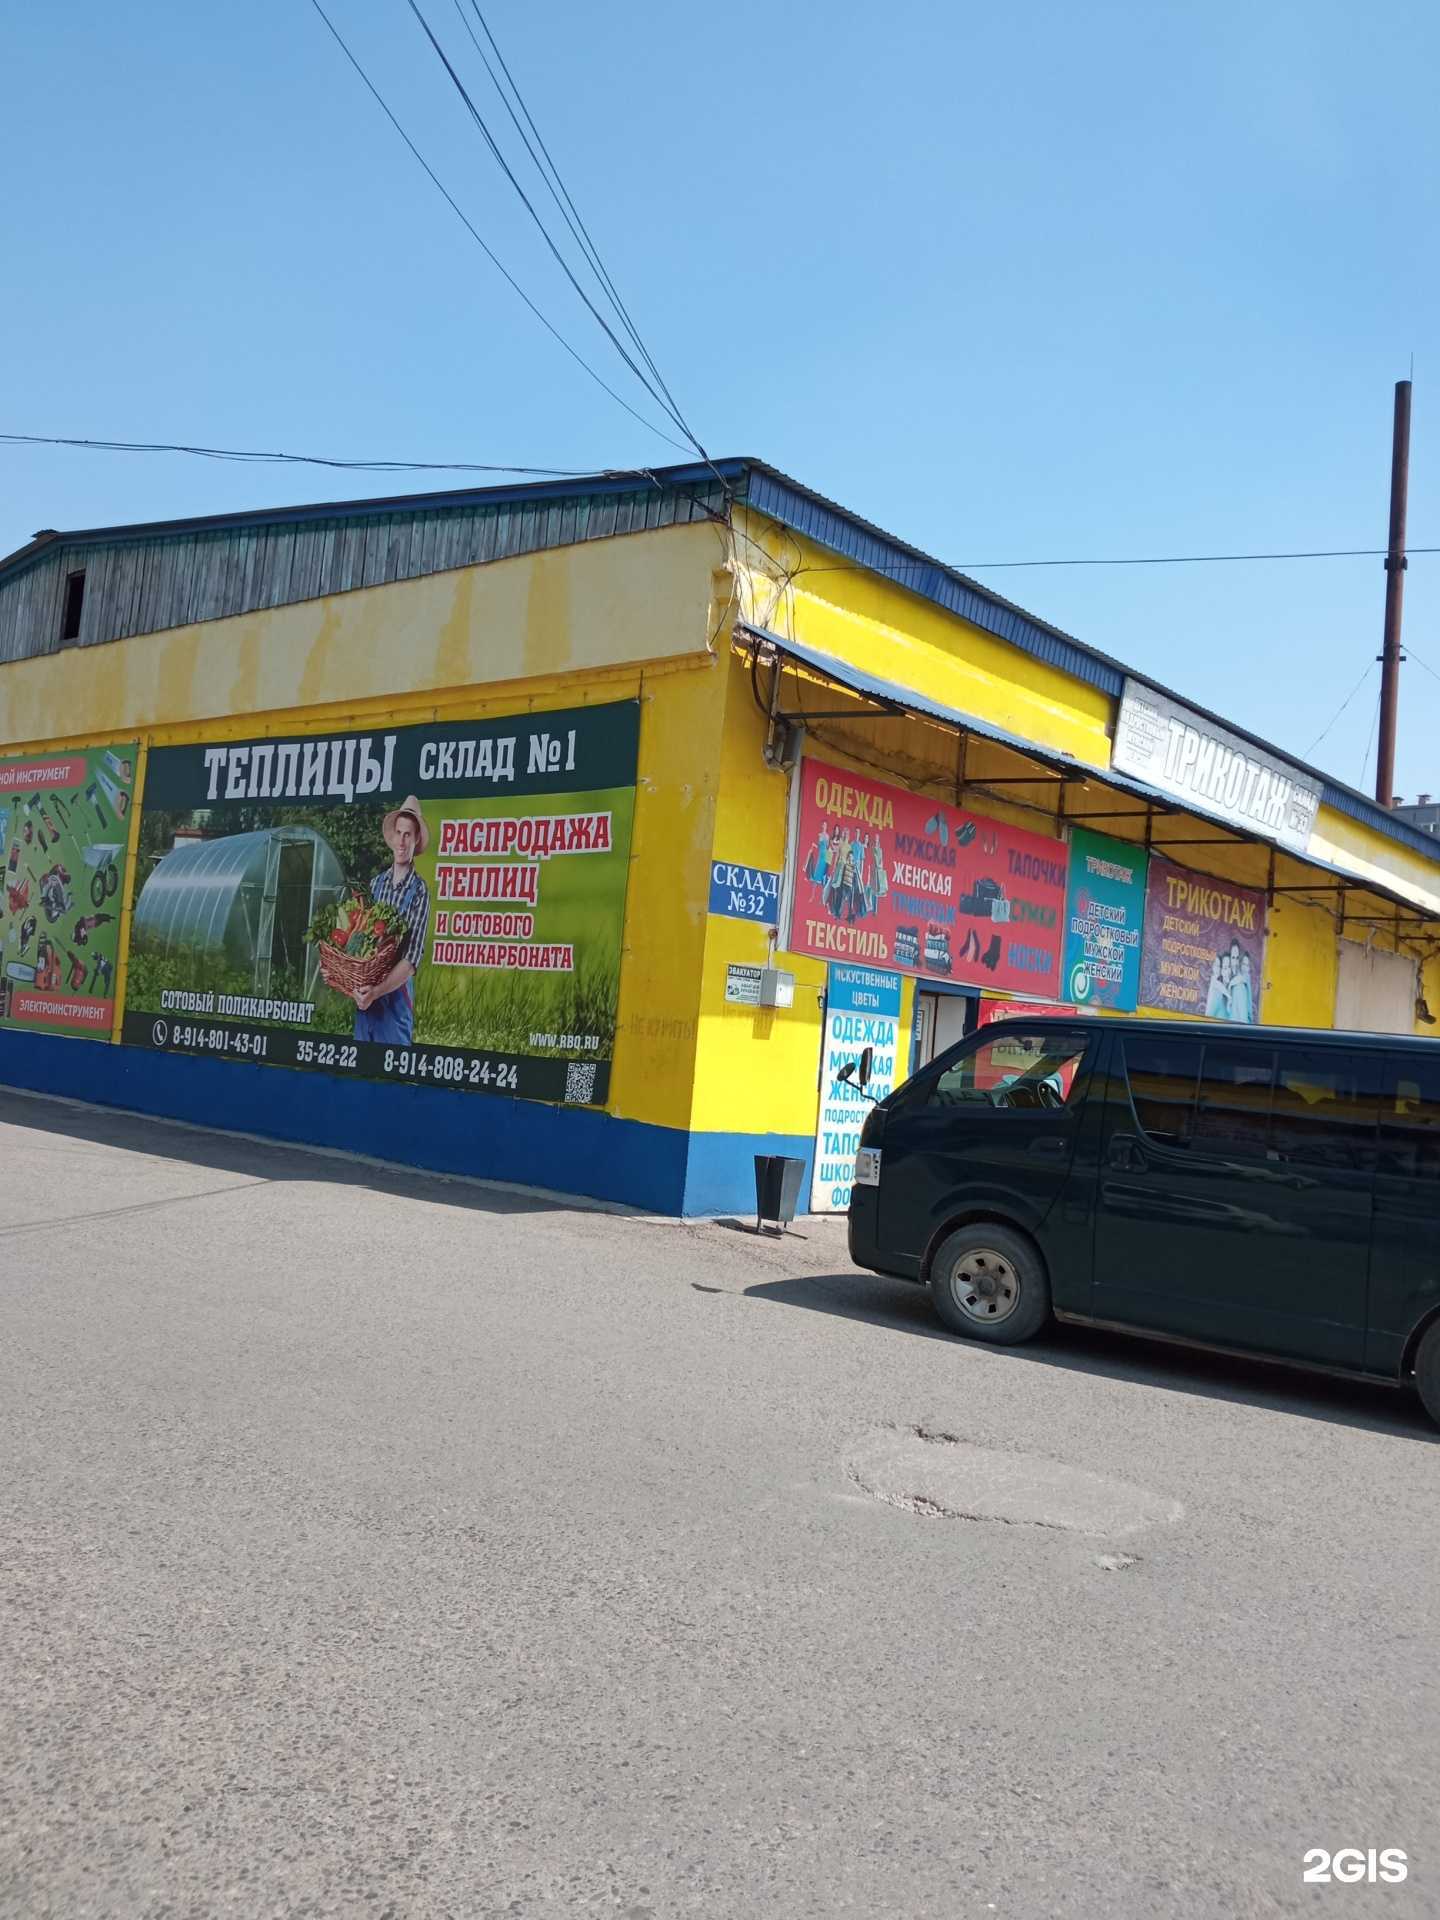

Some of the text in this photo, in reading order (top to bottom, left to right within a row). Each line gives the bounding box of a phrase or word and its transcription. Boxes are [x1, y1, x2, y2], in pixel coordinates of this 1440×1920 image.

[16, 766, 71, 784] ИНСТРУМЕНТ
[204, 729, 577, 803] ТЕПЛИЦЫ СКЛАД №1
[1163, 715, 1293, 831] ТРИКОТАЖ
[815, 777, 895, 829] ОДЕЖДА
[439, 812, 612, 858] РАСПРОДАЖА
[895, 833, 957, 868] МУЖСКАЯ
[437, 865, 538, 905] ТЕПЛИЦ
[712, 862, 778, 899] СКЛАД
[892, 861, 953, 897] ЖЕНСКАЯ
[1008, 848, 1066, 889] ТАПОЧКИ
[727, 891, 765, 916] №32
[1087, 901, 1126, 925] ДЕТСКИЙ
[1166, 877, 1256, 930] ТРИКОТАЖ
[436, 912, 532, 937] И СОТОВОГО
[806, 919, 888, 960] ТЕКСТИЛЬ
[1071, 917, 1139, 948] ПОДРОСТКОВЫЙ
[433, 942, 574, 970] ПОЛИКАРБОНАТА
[1084, 940, 1125, 963] МУЖСКОЙ
[835, 968, 898, 991] ИСКУСТВЕННЫЕ
[1082, 960, 1122, 983] ЖЕНСКИЙ
[20, 1000, 105, 1020] ЭЛЕКТРОИНСТРУМЕНТ
[161, 989, 315, 1024] СОТОВЫЙ ПОЛИКАРБОНАТ
[852, 991, 880, 1008] ЦВЕТЫ
[832, 1015, 895, 1047] ОДЕЖДА
[172, 1024, 518, 1089] 8-914-801-43-01 35-22-22 8-914-808-24-24
[829, 1050, 894, 1077] МУЖКАЯ
